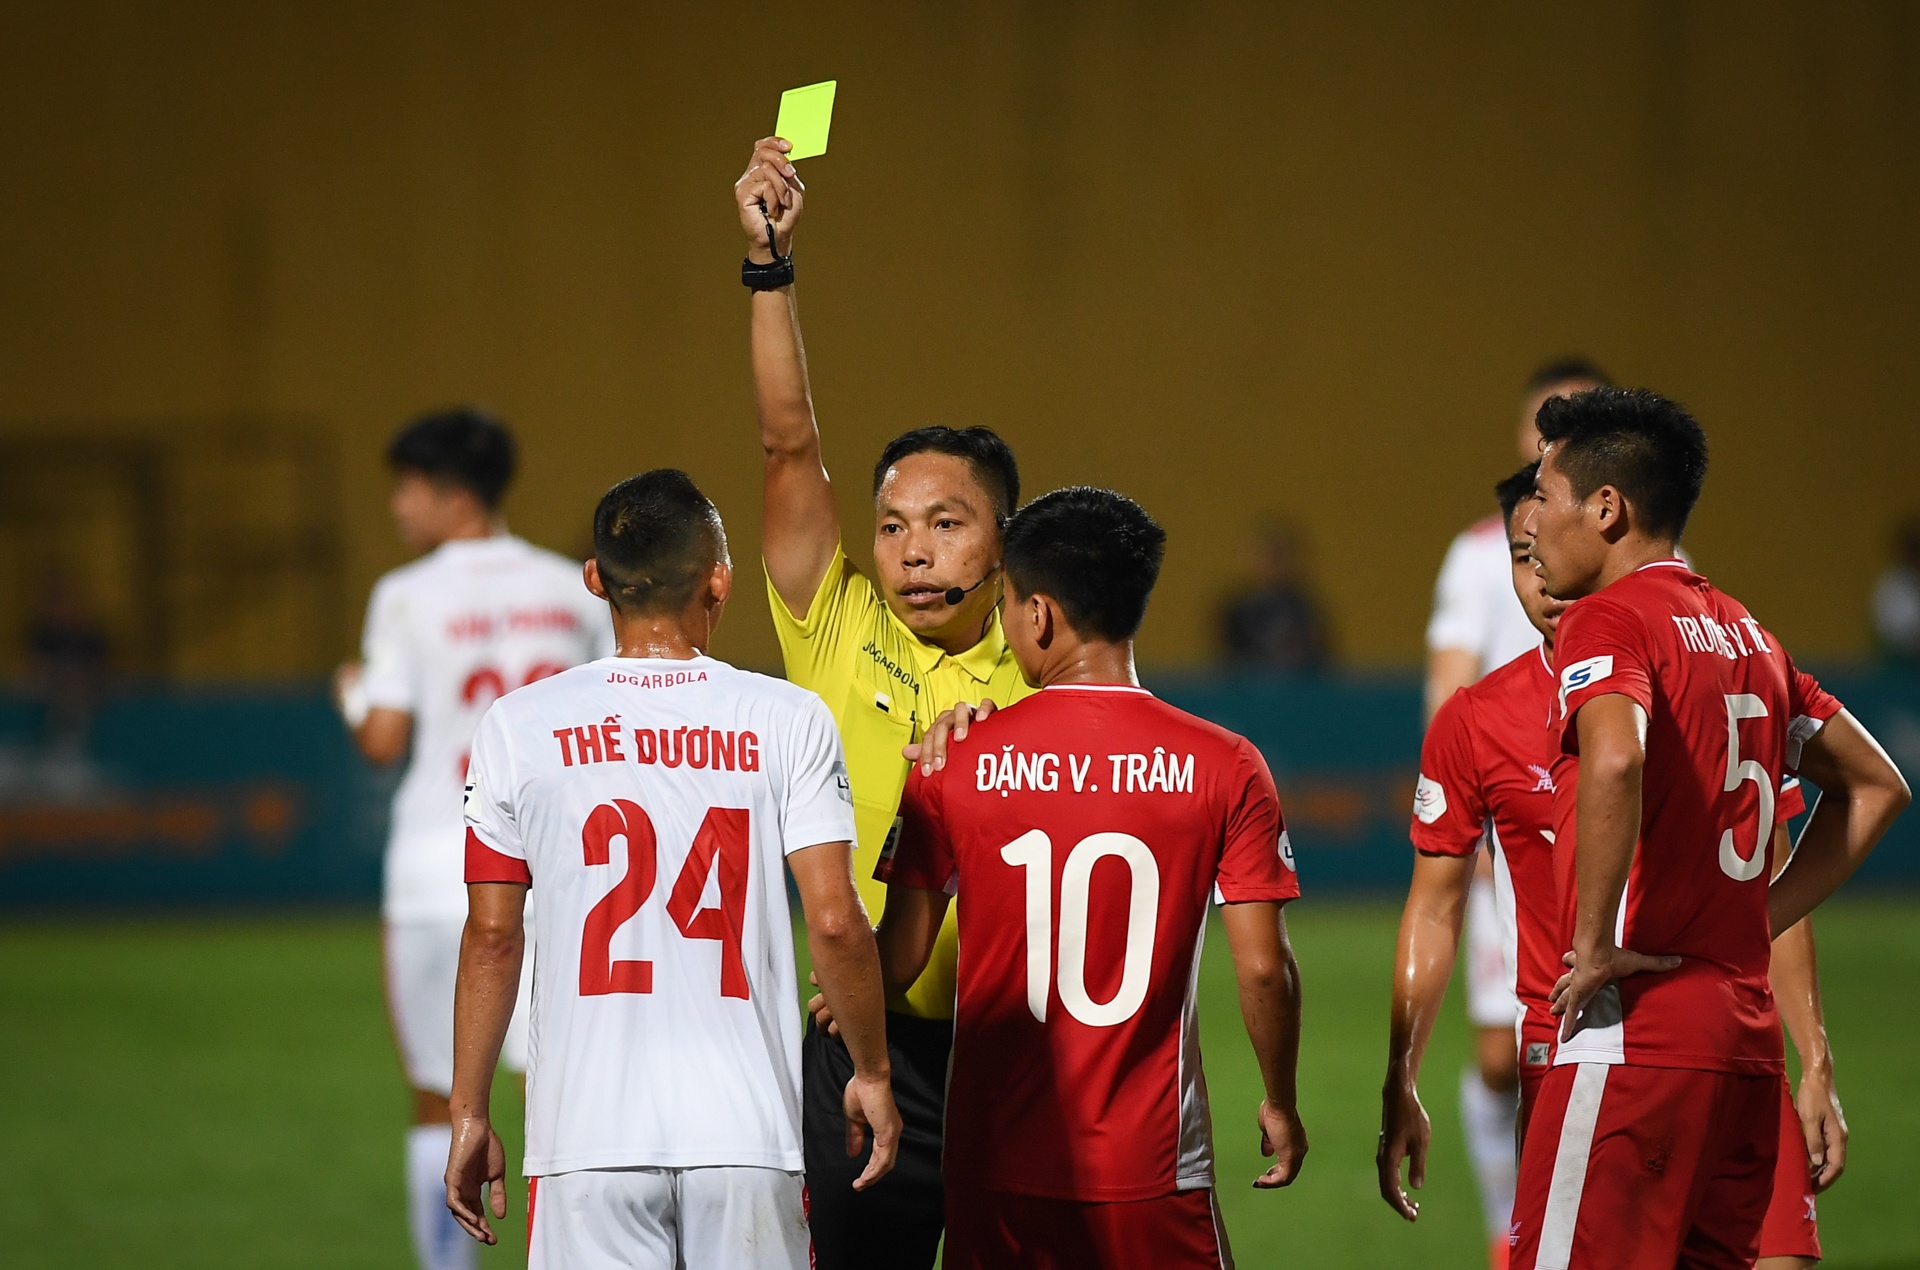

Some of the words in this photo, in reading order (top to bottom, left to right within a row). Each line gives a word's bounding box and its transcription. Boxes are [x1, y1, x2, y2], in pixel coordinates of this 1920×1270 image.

[1725, 622, 1753, 657] V.
[606, 671, 708, 689] JOGARBOLA
[862, 640, 920, 696] JOGARBOLA
[552, 713, 626, 768] THẾ
[975, 744, 1059, 798] ĐẶNG
[1068, 754, 1099, 793] V.
[1107, 746, 1195, 794] TRÂM
[1718, 693, 1774, 881] 5
[579, 798, 750, 1000] 24
[1000, 828, 1160, 1027] 10
